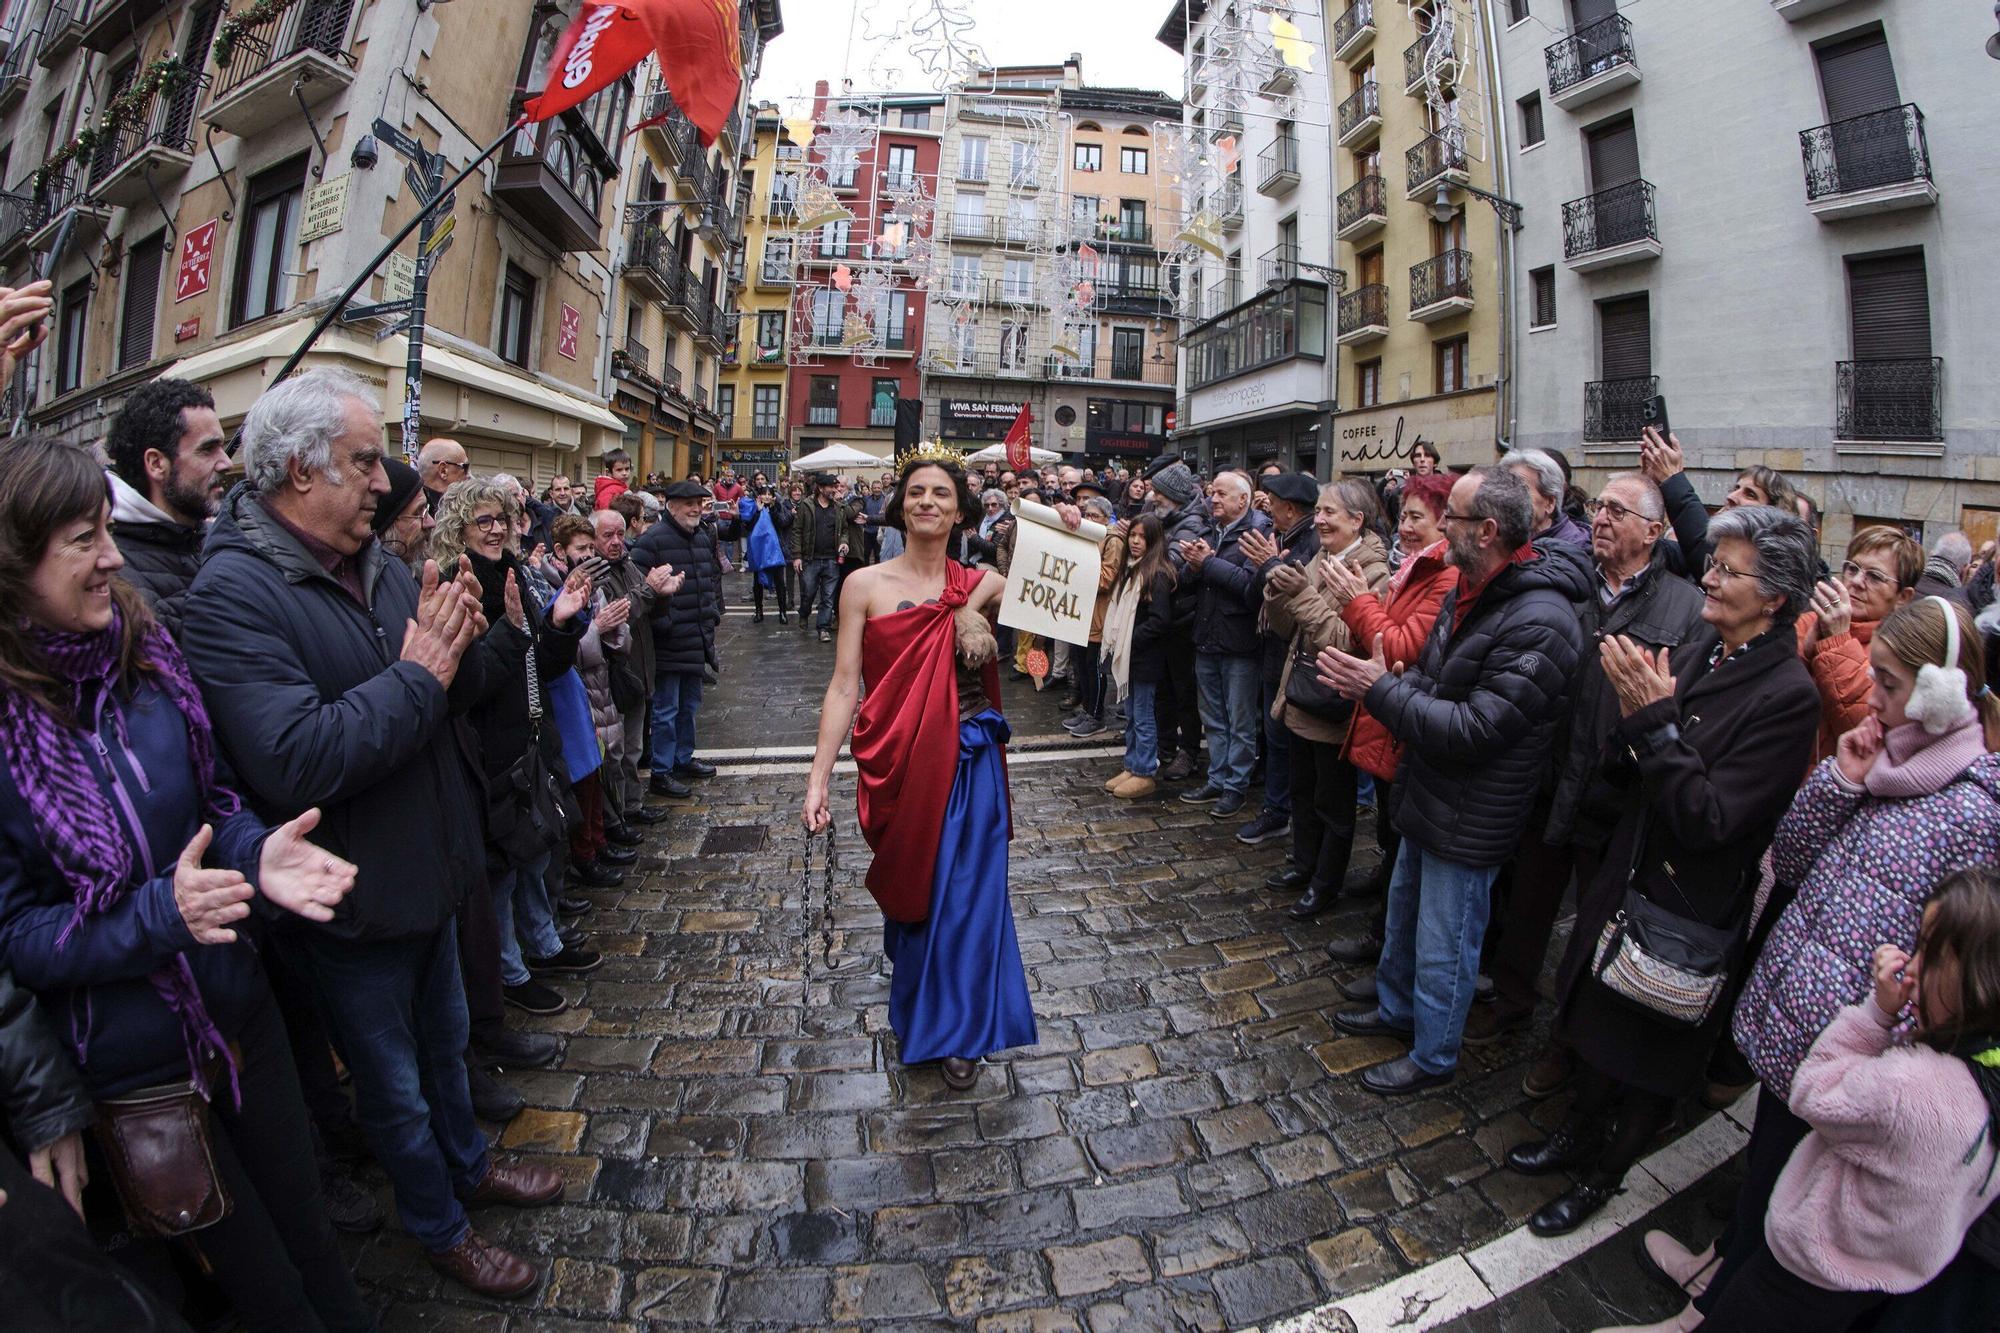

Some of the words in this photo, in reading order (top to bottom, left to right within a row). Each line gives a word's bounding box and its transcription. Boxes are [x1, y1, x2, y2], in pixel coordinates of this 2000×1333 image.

[971, 403, 990, 412] SAN
[1342, 425, 1377, 440] COFFEE
[1038, 550, 1077, 585] LEY
[1018, 577, 1081, 622] FORAL
